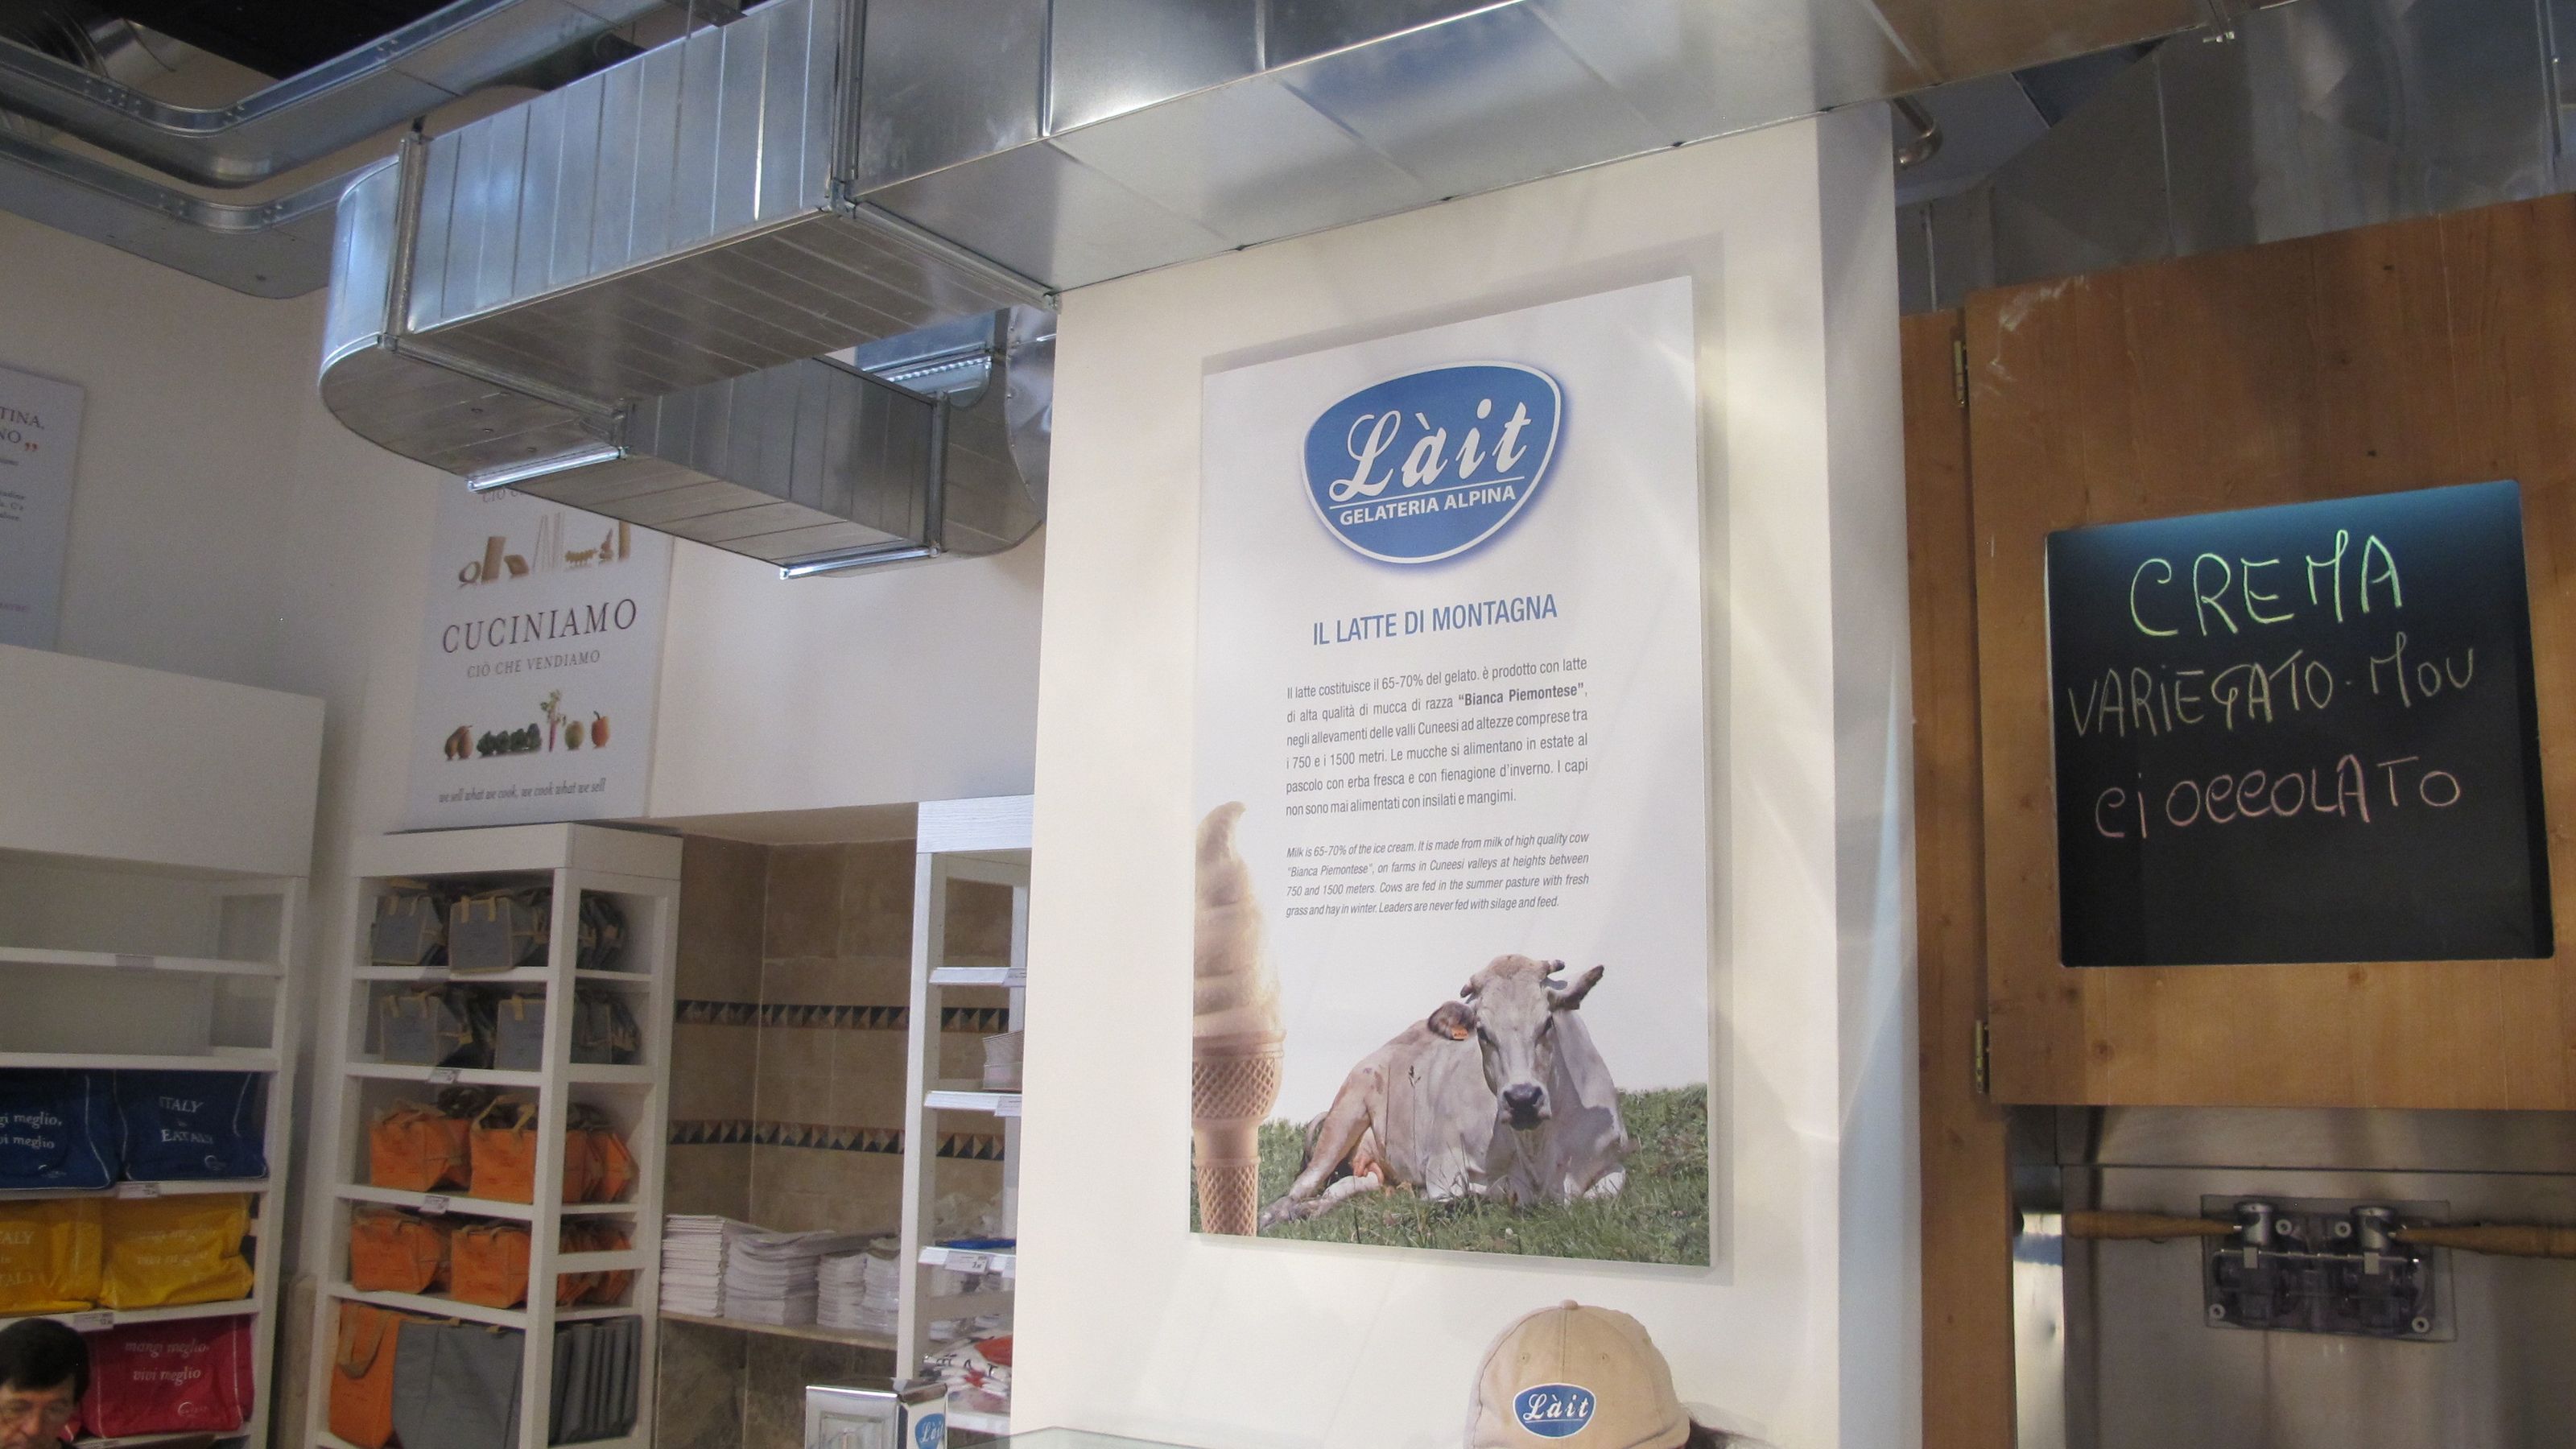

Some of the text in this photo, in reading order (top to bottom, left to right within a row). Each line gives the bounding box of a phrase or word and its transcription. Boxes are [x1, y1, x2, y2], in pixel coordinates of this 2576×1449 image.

[1328, 398, 1531, 502] Làit
[1340, 485, 1517, 526] GELATERIA ALPINA
[2130, 529, 2403, 637] CREMA
[443, 598, 637, 653] CUCINIAMO
[1313, 593, 1558, 646] IL LATTE DI MONTAGNA
[496, 658, 522, 675] CHE
[527, 650, 601, 670] VENDIAMO
[1295, 685, 1316, 698] latte
[1318, 681, 1371, 696] costituisce
[1381, 674, 1423, 689] 65-70%
[1426, 671, 1442, 685] del
[1444, 668, 1480, 686] gelato.
[1482, 666, 1489, 679] è
[1492, 662, 1537, 681] prodotto
[1539, 661, 1559, 674] con
[1563, 657, 1587, 671] latte
[1287, 712, 1295, 722] di
[1300, 709, 1317, 721] alta
[1322, 706, 1354, 720] qualità
[1359, 704, 1368, 716] di
[1373, 702, 1406, 713] mucca
[1411, 699, 1420, 711] di
[1426, 698, 1452, 709] razza
[1286, 709, 1587, 747] negli allevamenti delle valli Cuneesi ad altezze comprese tra
[1292, 755, 1311, 769] 750
[1330, 751, 1356, 766] 1500
[1358, 749, 1387, 763] metri.
[1390, 748, 1403, 761] Le
[1406, 745, 1447, 759] mucche
[1450, 742, 1459, 756] si
[1463, 740, 1523, 755] alimentano
[1526, 737, 1536, 750] in
[1539, 734, 1575, 749] estate
[1577, 732, 1587, 746] al
[1286, 778, 1323, 795] pascolo
[1326, 778, 1344, 790] con
[1348, 775, 1370, 788] erba
[1373, 774, 1405, 786] fresca
[1418, 772, 1437, 783] con
[1440, 766, 1496, 782] fienagione
[1564, 758, 1587, 774] capi
[1286, 805, 1303, 815] non
[1305, 803, 1328, 815] sono
[1331, 801, 1348, 812] mai
[1350, 797, 1400, 811] alimentati
[1402, 797, 1420, 808] con
[1422, 793, 1455, 806] insilati
[1467, 790, 1516, 805] mangimi.
[1286, 847, 1303, 857] Milk
[1305, 848, 1312, 857] is
[1313, 844, 1346, 856] 65-70%
[1348, 844, 1357, 855] of
[1358, 844, 1371, 854] the
[1373, 843, 1385, 853] ice
[1387, 843, 1415, 852] cream.
[1425, 840, 1433, 850] is
[1435, 839, 1459, 849] made
[1460, 838, 1481, 848] from
[1483, 836, 1502, 847] milk
[1504, 835, 1514, 847] of
[1514, 835, 1534, 848] high
[1536, 833, 1567, 846] quality
[1569, 833, 1588, 843] cow
[1377, 864, 1388, 873] on
[1391, 861, 1415, 872] farms
[1418, 861, 1426, 871] in
[1429, 858, 1464, 870] Cuneesi
[1468, 857, 1497, 869] valleys
[1500, 856, 1509, 867] at
[1512, 855, 1546, 869] heights
[1549, 853, 1588, 865] between
[1286, 873, 1589, 896] 750 and 1500 meters. Cows are fed in the summer pasture with fresh
[1285, 895, 1558, 918] grass and hay in winter. Leaders are never fed with silage and feed.
[159, 1096, 205, 1113] ITALY
[12, 1135, 56, 1150] meglio
[160, 1366, 201, 1386] meglio
[1522, 1393, 1590, 1420] Làit
